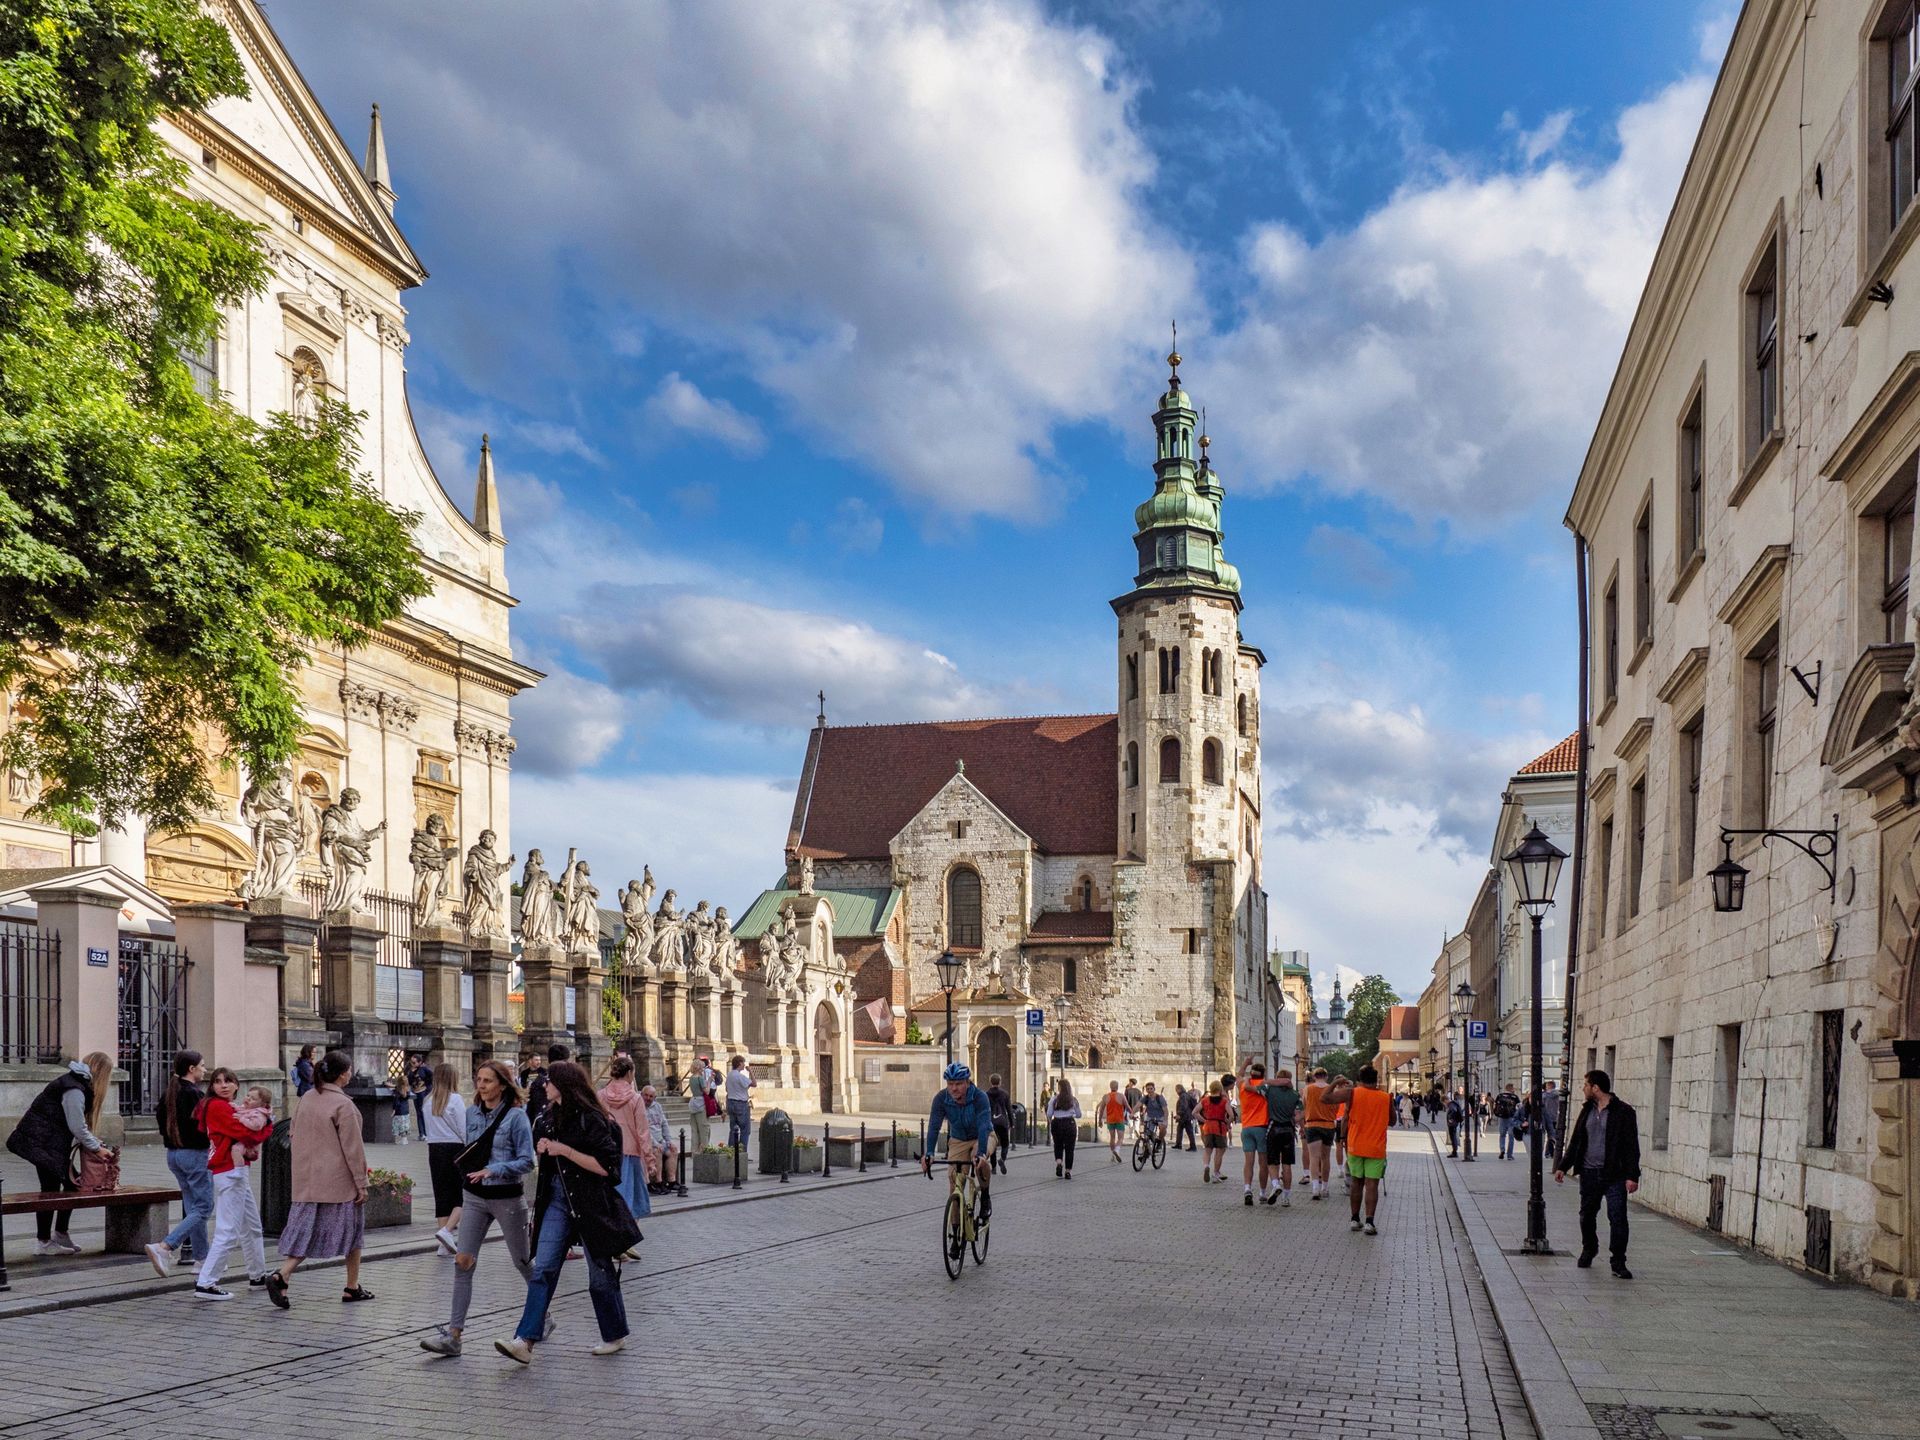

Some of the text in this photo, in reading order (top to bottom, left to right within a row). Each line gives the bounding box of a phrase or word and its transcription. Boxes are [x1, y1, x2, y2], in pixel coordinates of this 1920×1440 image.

[91, 952, 107, 962] 52A
[1030, 1011, 1040, 1024] P
[1473, 1023, 1484, 1036] P
